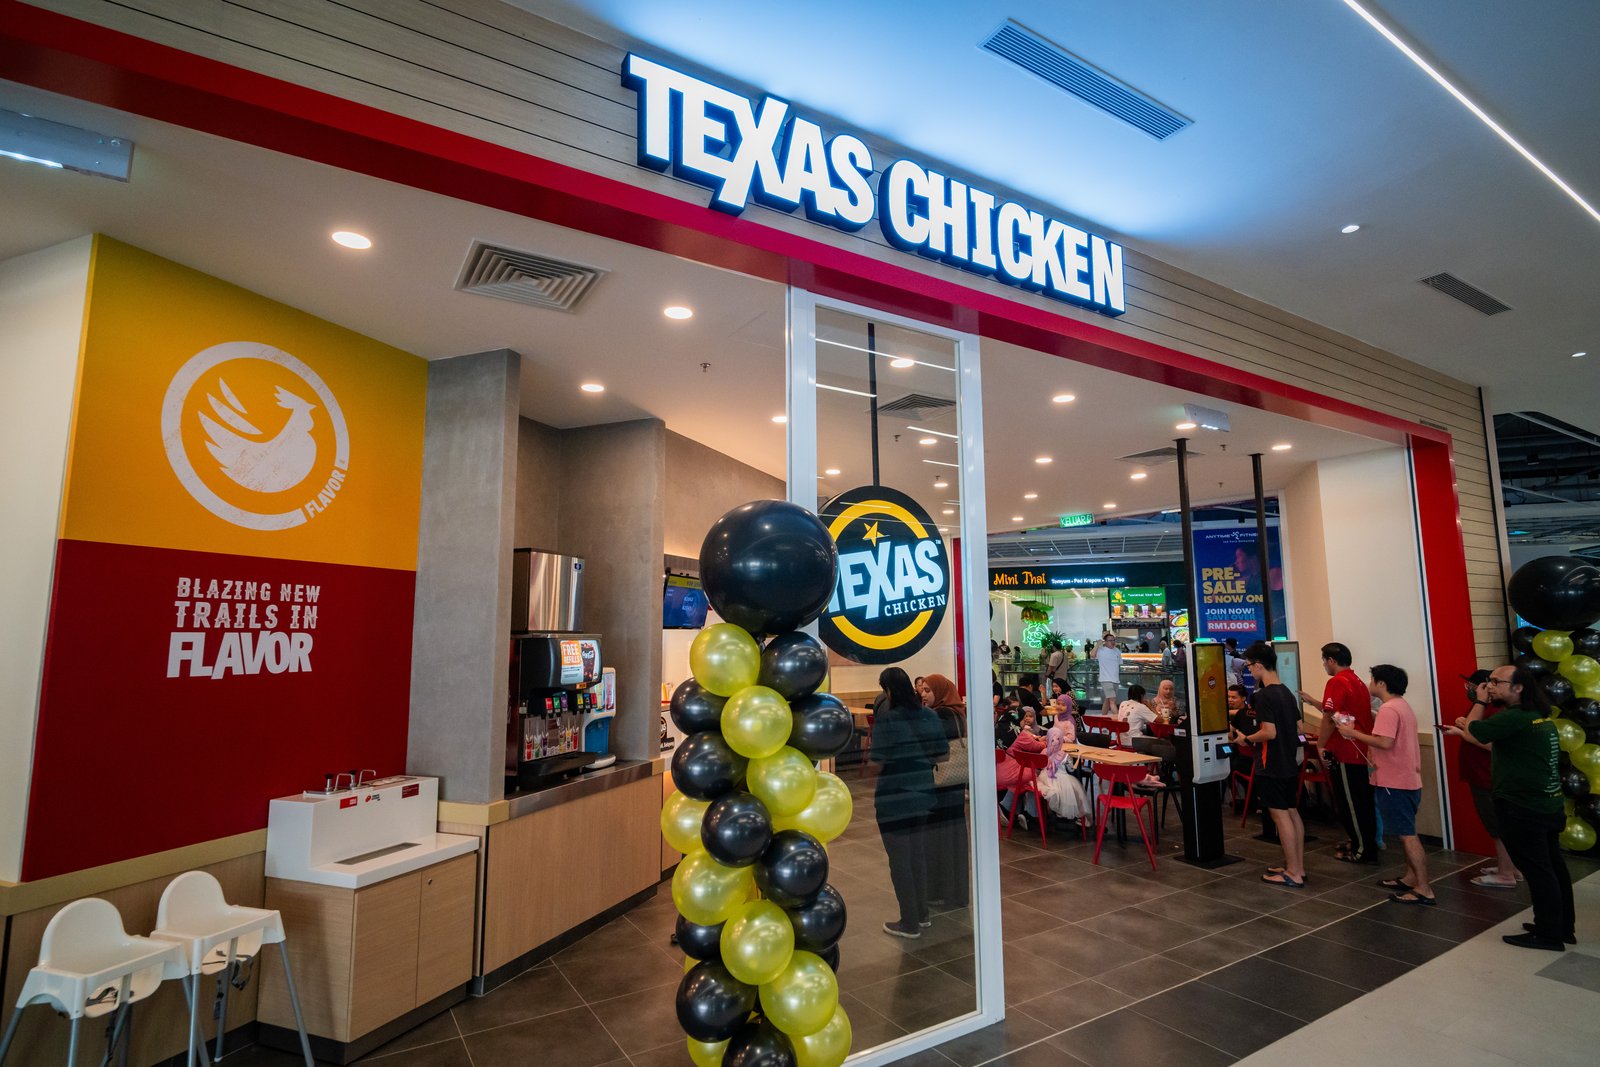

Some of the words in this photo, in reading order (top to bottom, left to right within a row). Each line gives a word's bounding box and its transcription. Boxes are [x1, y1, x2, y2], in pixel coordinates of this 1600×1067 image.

[626, 53, 875, 228] TEXAS
[886, 159, 1125, 313] CHICKEN
[305, 469, 346, 518] FLAVOR
[993, 572, 1019, 585] Mini
[1021, 570, 1047, 585] Thai
[1202, 567, 1241, 581] PRE-
[177, 577, 272, 601] BLAZING
[280, 583, 321, 603] NEW
[1203, 580, 1246, 594] SALE
[884, 594, 946, 617] CHICKEN
[1204, 595, 1213, 604] IS
[1215, 595, 1244, 604] NOW
[1245, 594, 1264, 603] ON
[174, 601, 279, 629] TRAILS
[290, 605, 318, 629] IN
[1228, 607, 1255, 615] NOW!
[1207, 622, 1256, 630] RM1,000+
[166, 630, 314, 680] FLAVOR
